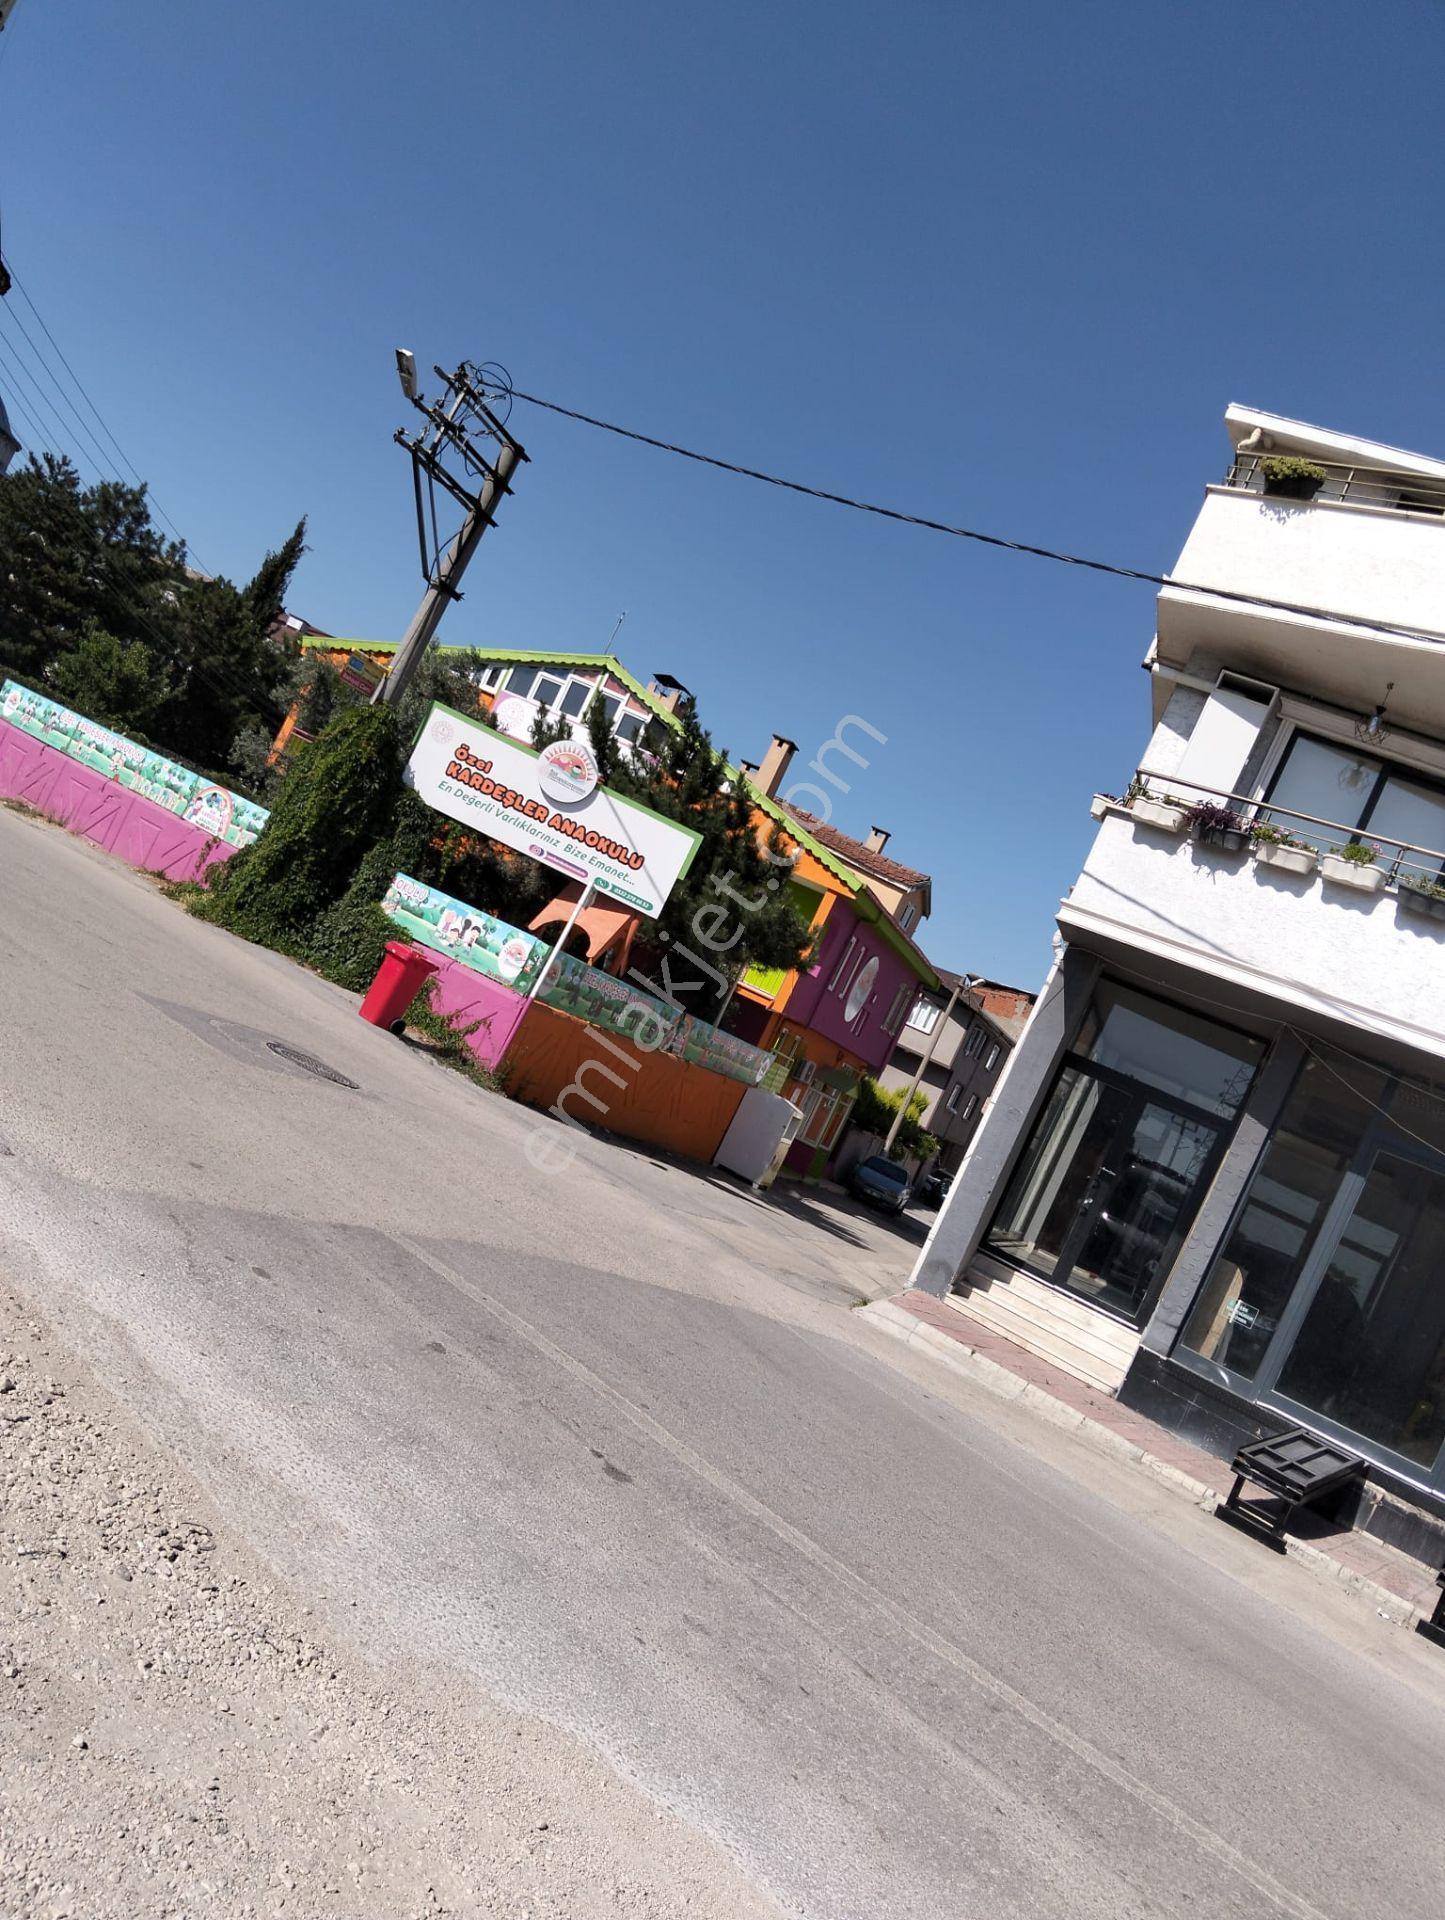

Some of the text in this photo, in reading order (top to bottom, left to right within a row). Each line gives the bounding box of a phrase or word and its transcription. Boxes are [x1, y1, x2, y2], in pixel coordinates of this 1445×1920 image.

[454, 743, 493, 774] Özel
[438, 780, 452, 793] En
[453, 786, 494, 816] Değerli
[495, 808, 560, 848] Varlıklarınız
[563, 842, 588, 862] Bize
[446, 761, 549, 822] KARDEŞLER
[549, 814, 644, 870] ANAOKULU
